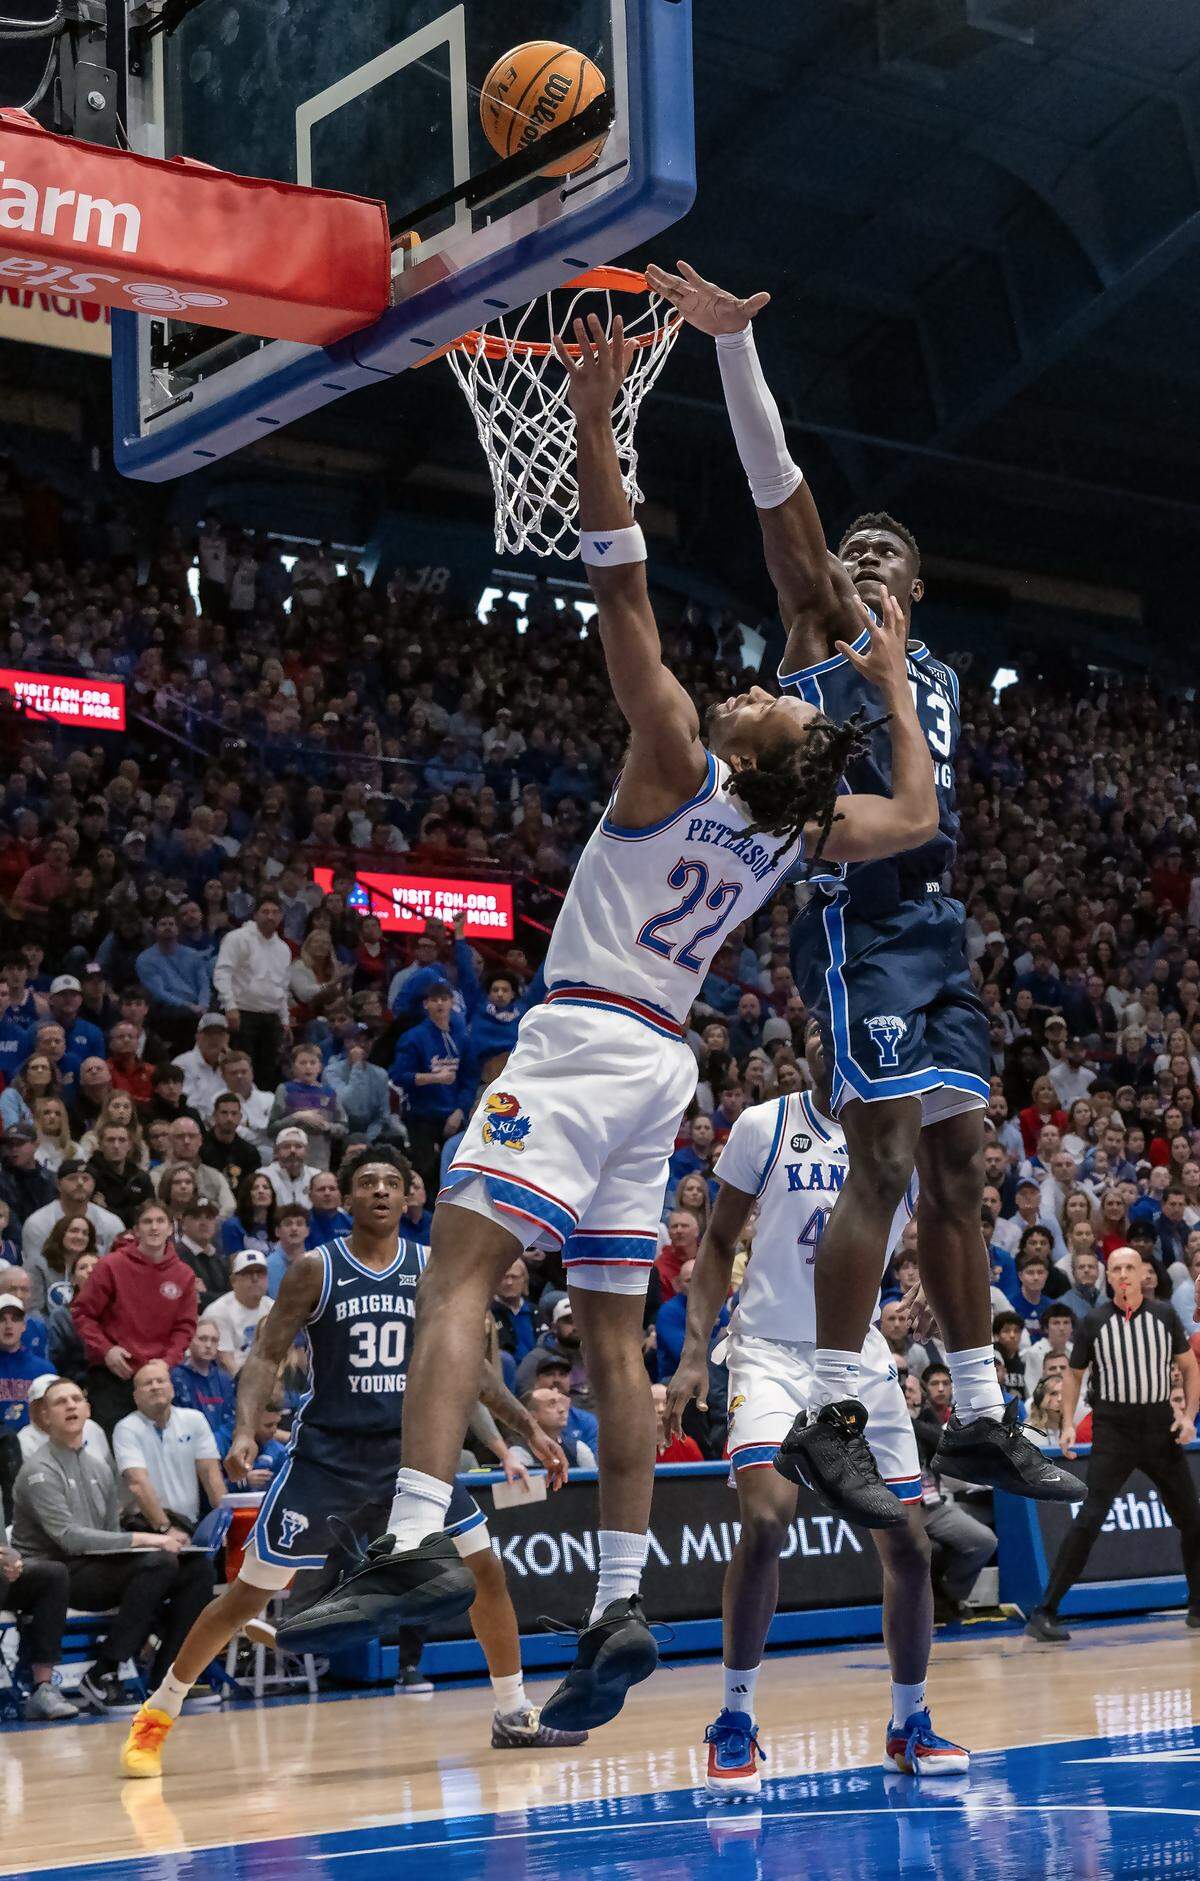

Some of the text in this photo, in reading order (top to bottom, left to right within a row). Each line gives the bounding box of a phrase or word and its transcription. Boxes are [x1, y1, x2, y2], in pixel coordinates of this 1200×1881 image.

[0, 160, 141, 253] arm
[14, 682, 50, 697] VISIT
[35, 697, 79, 715] LEARN
[82, 703, 120, 720] MORE
[392, 888, 431, 905] VISIT
[466, 910, 508, 927] MORE
[636, 856, 743, 974] 22
[497, 1121, 516, 1133] KU
[792, 1137, 810, 1150] SW
[348, 1321, 406, 1367] 30
[348, 1374, 407, 1393] YOUNG
